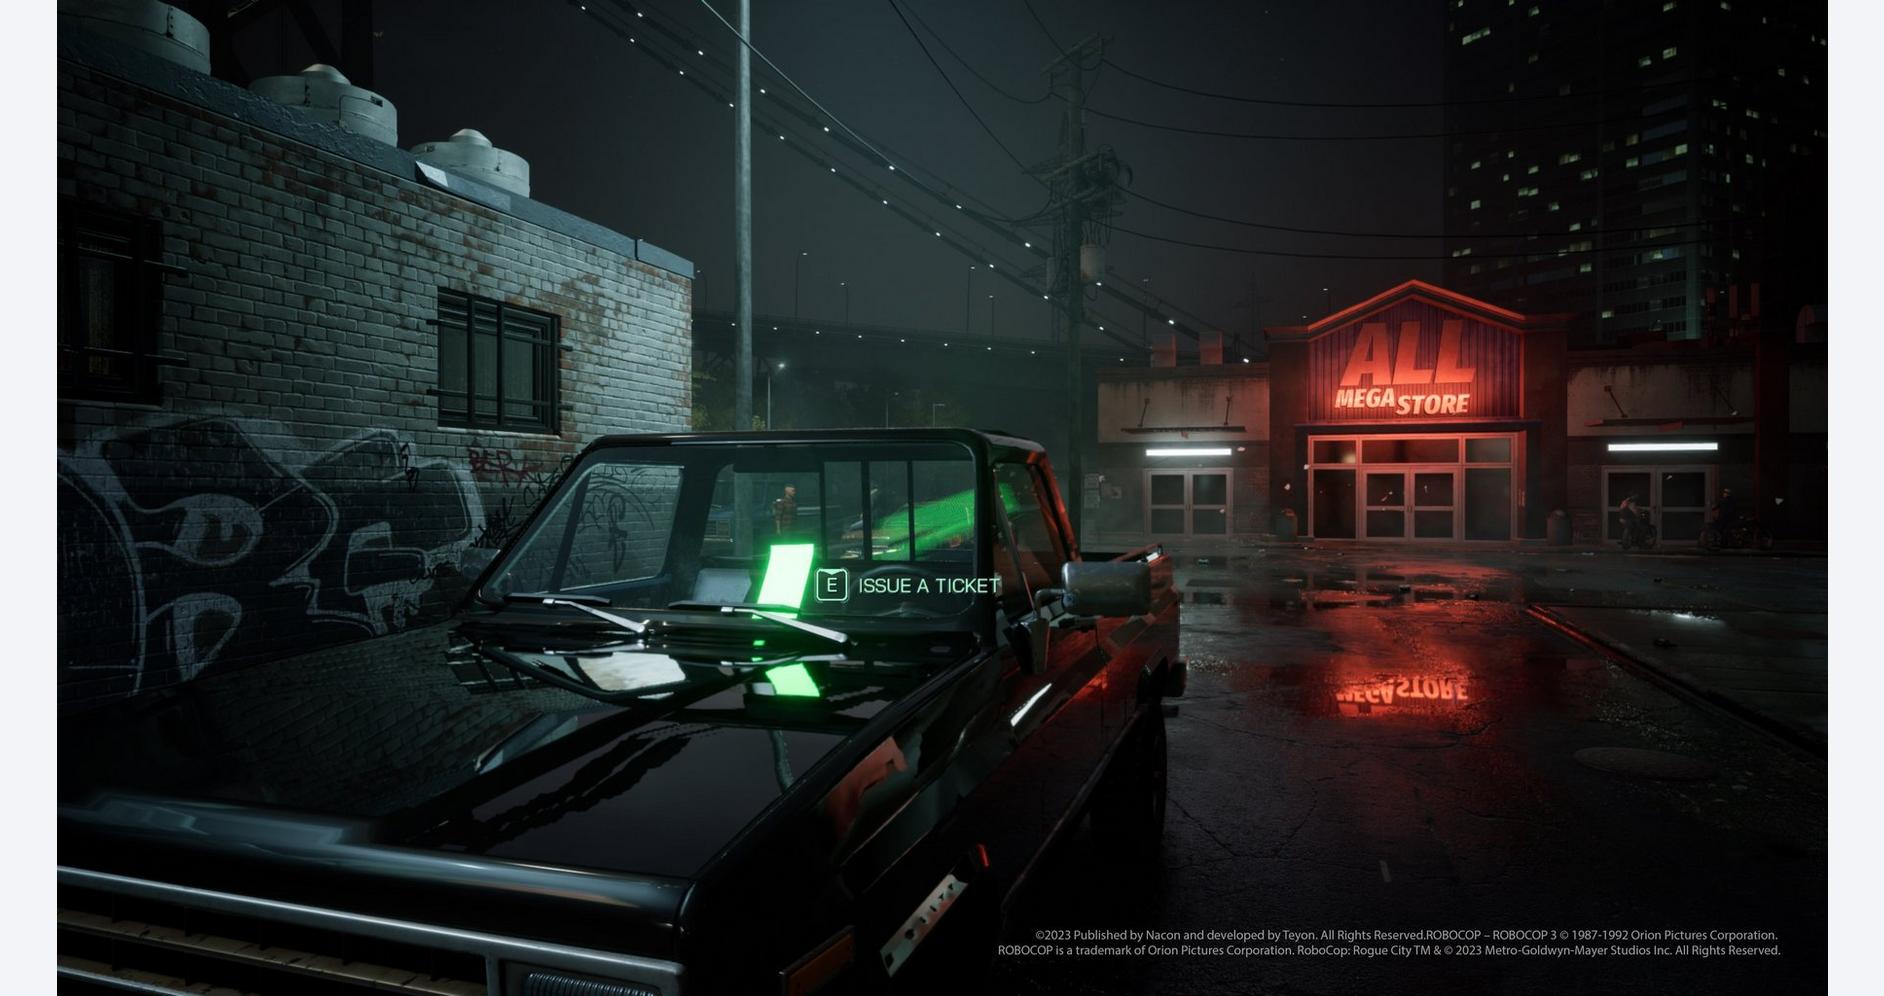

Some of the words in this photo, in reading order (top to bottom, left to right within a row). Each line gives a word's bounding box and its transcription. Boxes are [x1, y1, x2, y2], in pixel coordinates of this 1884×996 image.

[1340, 320, 1476, 386] ALL
[1334, 387, 1395, 409] MEGA
[1396, 393, 1471, 416] STORE
